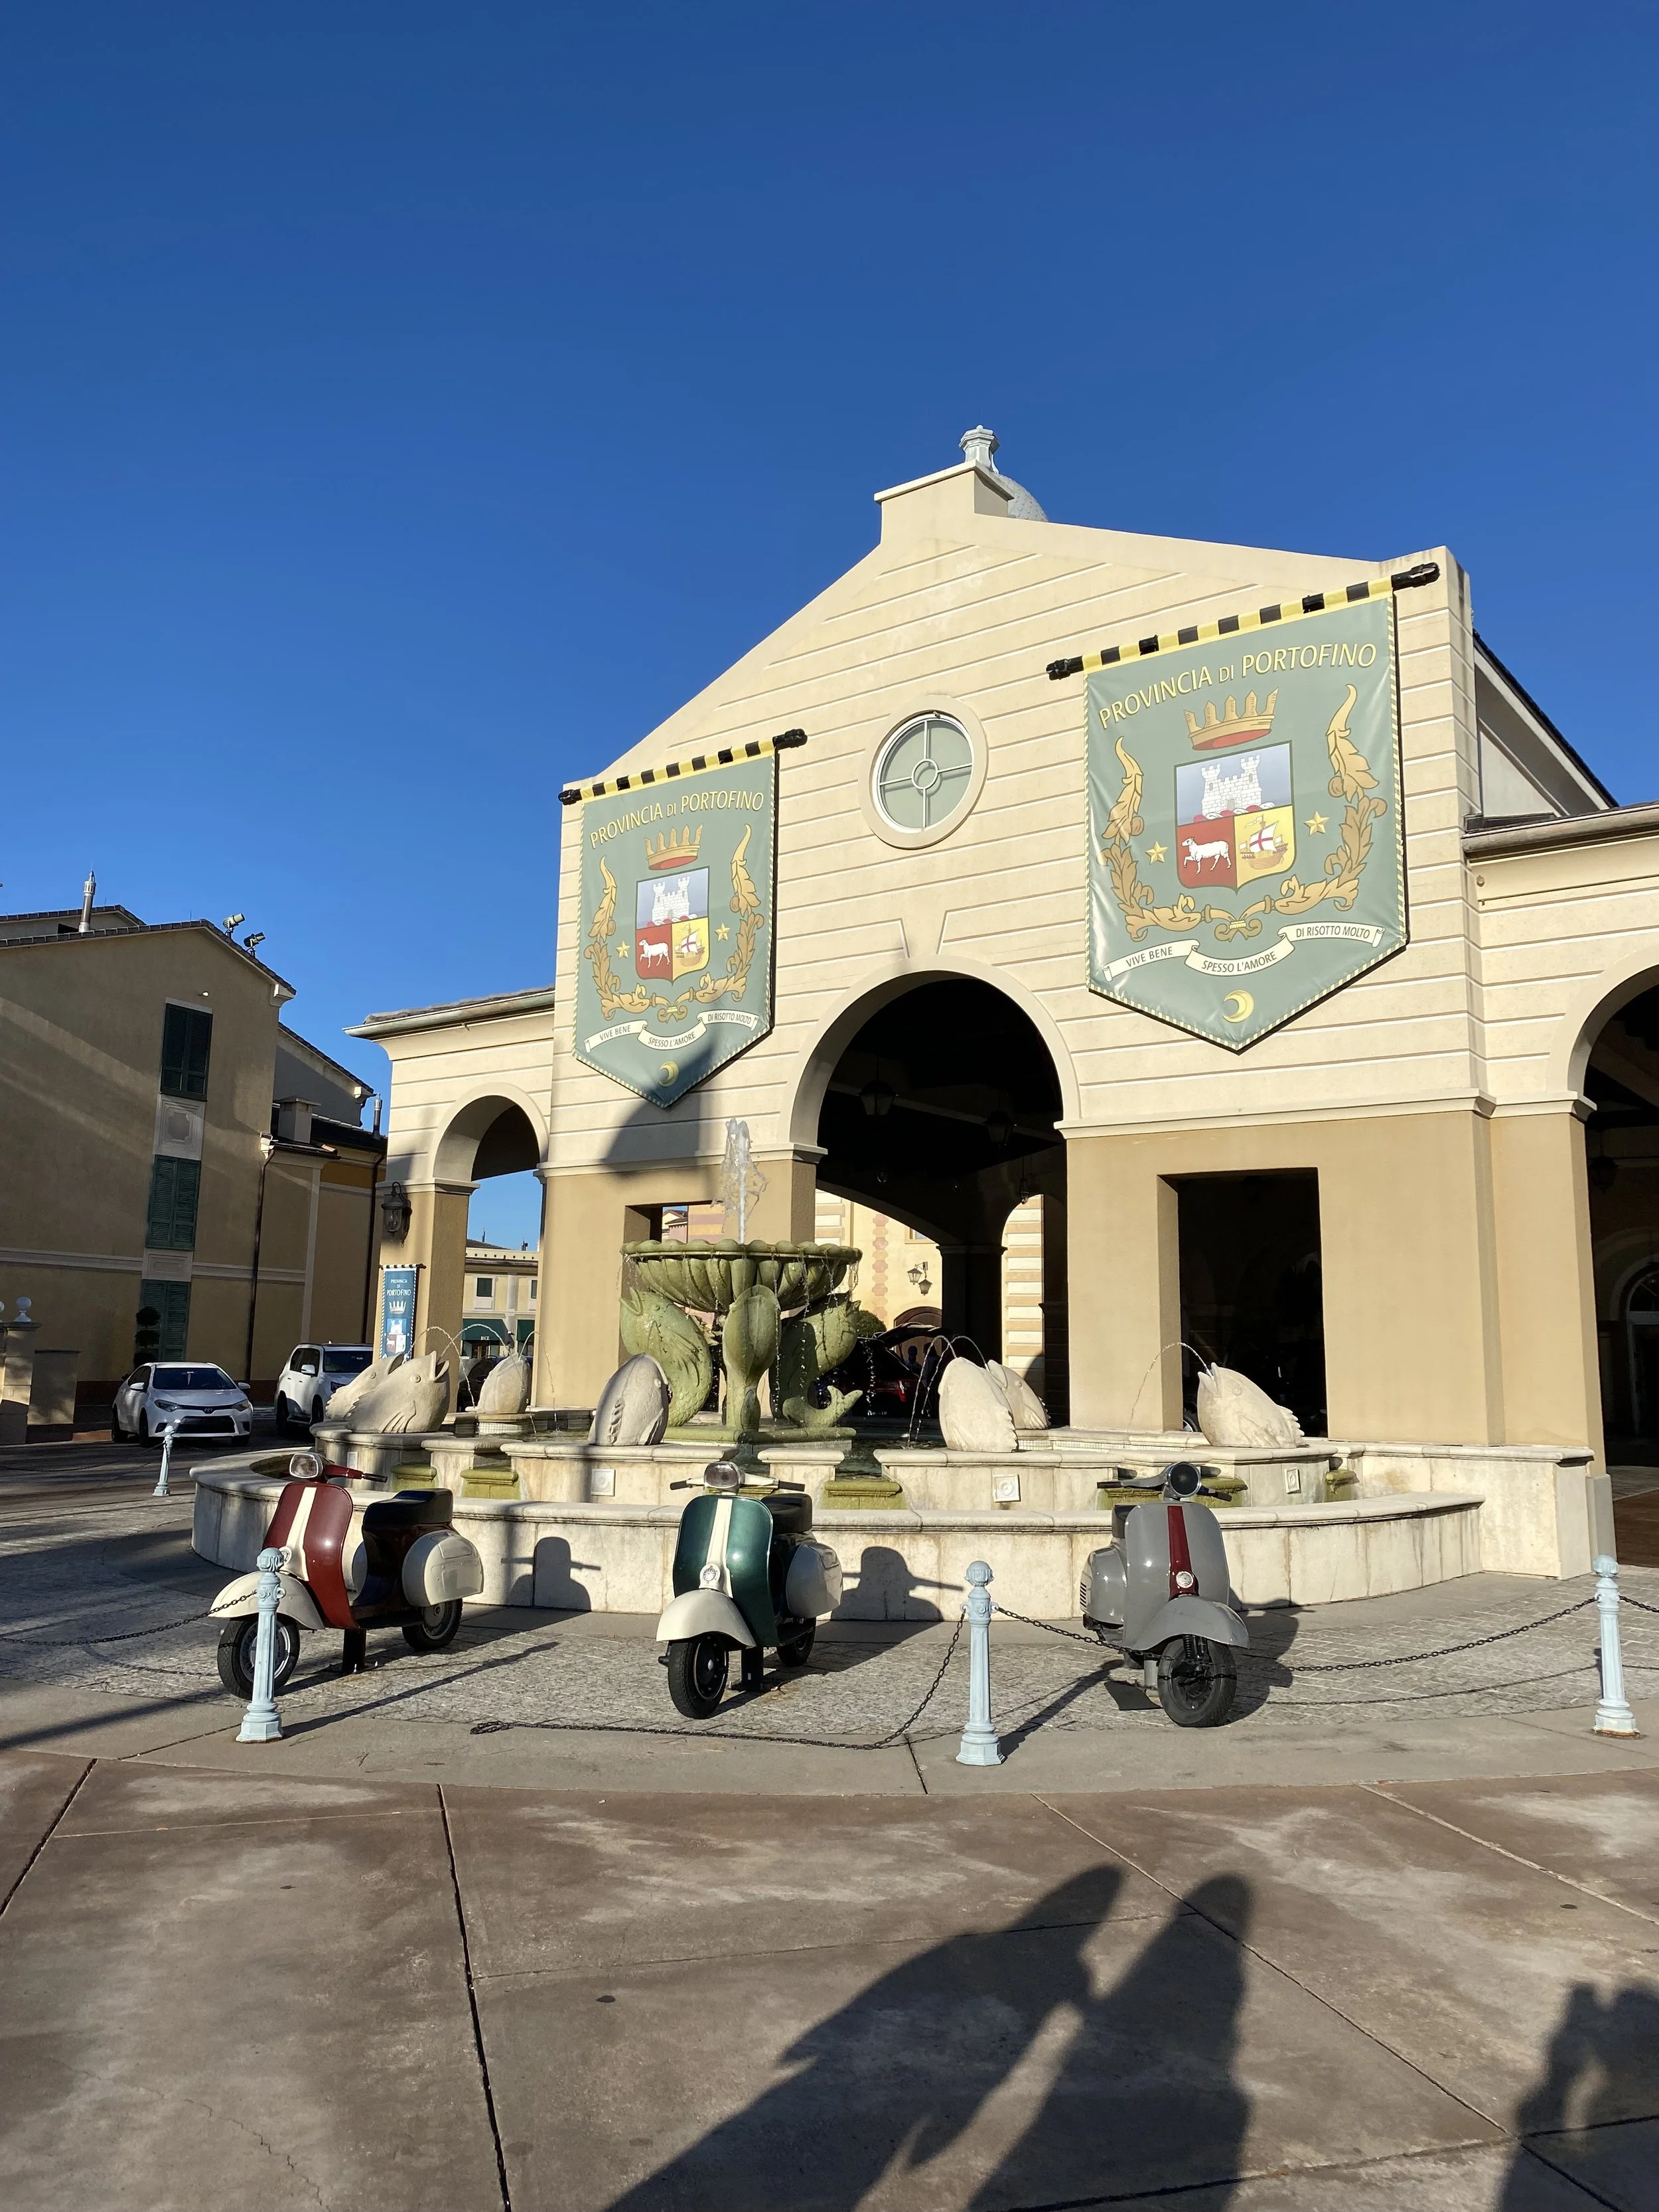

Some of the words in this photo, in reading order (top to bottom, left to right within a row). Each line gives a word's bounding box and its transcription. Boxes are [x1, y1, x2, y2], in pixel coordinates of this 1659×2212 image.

[1099, 666, 1213, 729] PROVINCIA
[1219, 666, 1234, 683] DI
[1241, 642, 1377, 678] PORTOFINO
[589, 802, 663, 849] PROVINCIA
[667, 803, 676, 817] DI
[681, 790, 764, 814] PORTOFINO
[1296, 928, 1305, 937] DI
[1307, 926, 1340, 936] RISOTTO
[1342, 927, 1370, 939] MOLTO
[1125, 953, 1147, 968] VIVE
[1149, 946, 1173, 960] BENE
[1201, 960, 1235, 973] SPESSO
[1237, 951, 1277, 972] L'AMORE
[736, 1015, 752, 1025] MOLTO
[599, 1030, 614, 1041] VIVE
[614, 1025, 631, 1035] BENE
[648, 1037, 669, 1047] SPESSO
[670, 1031, 695, 1047] L'AMORE
